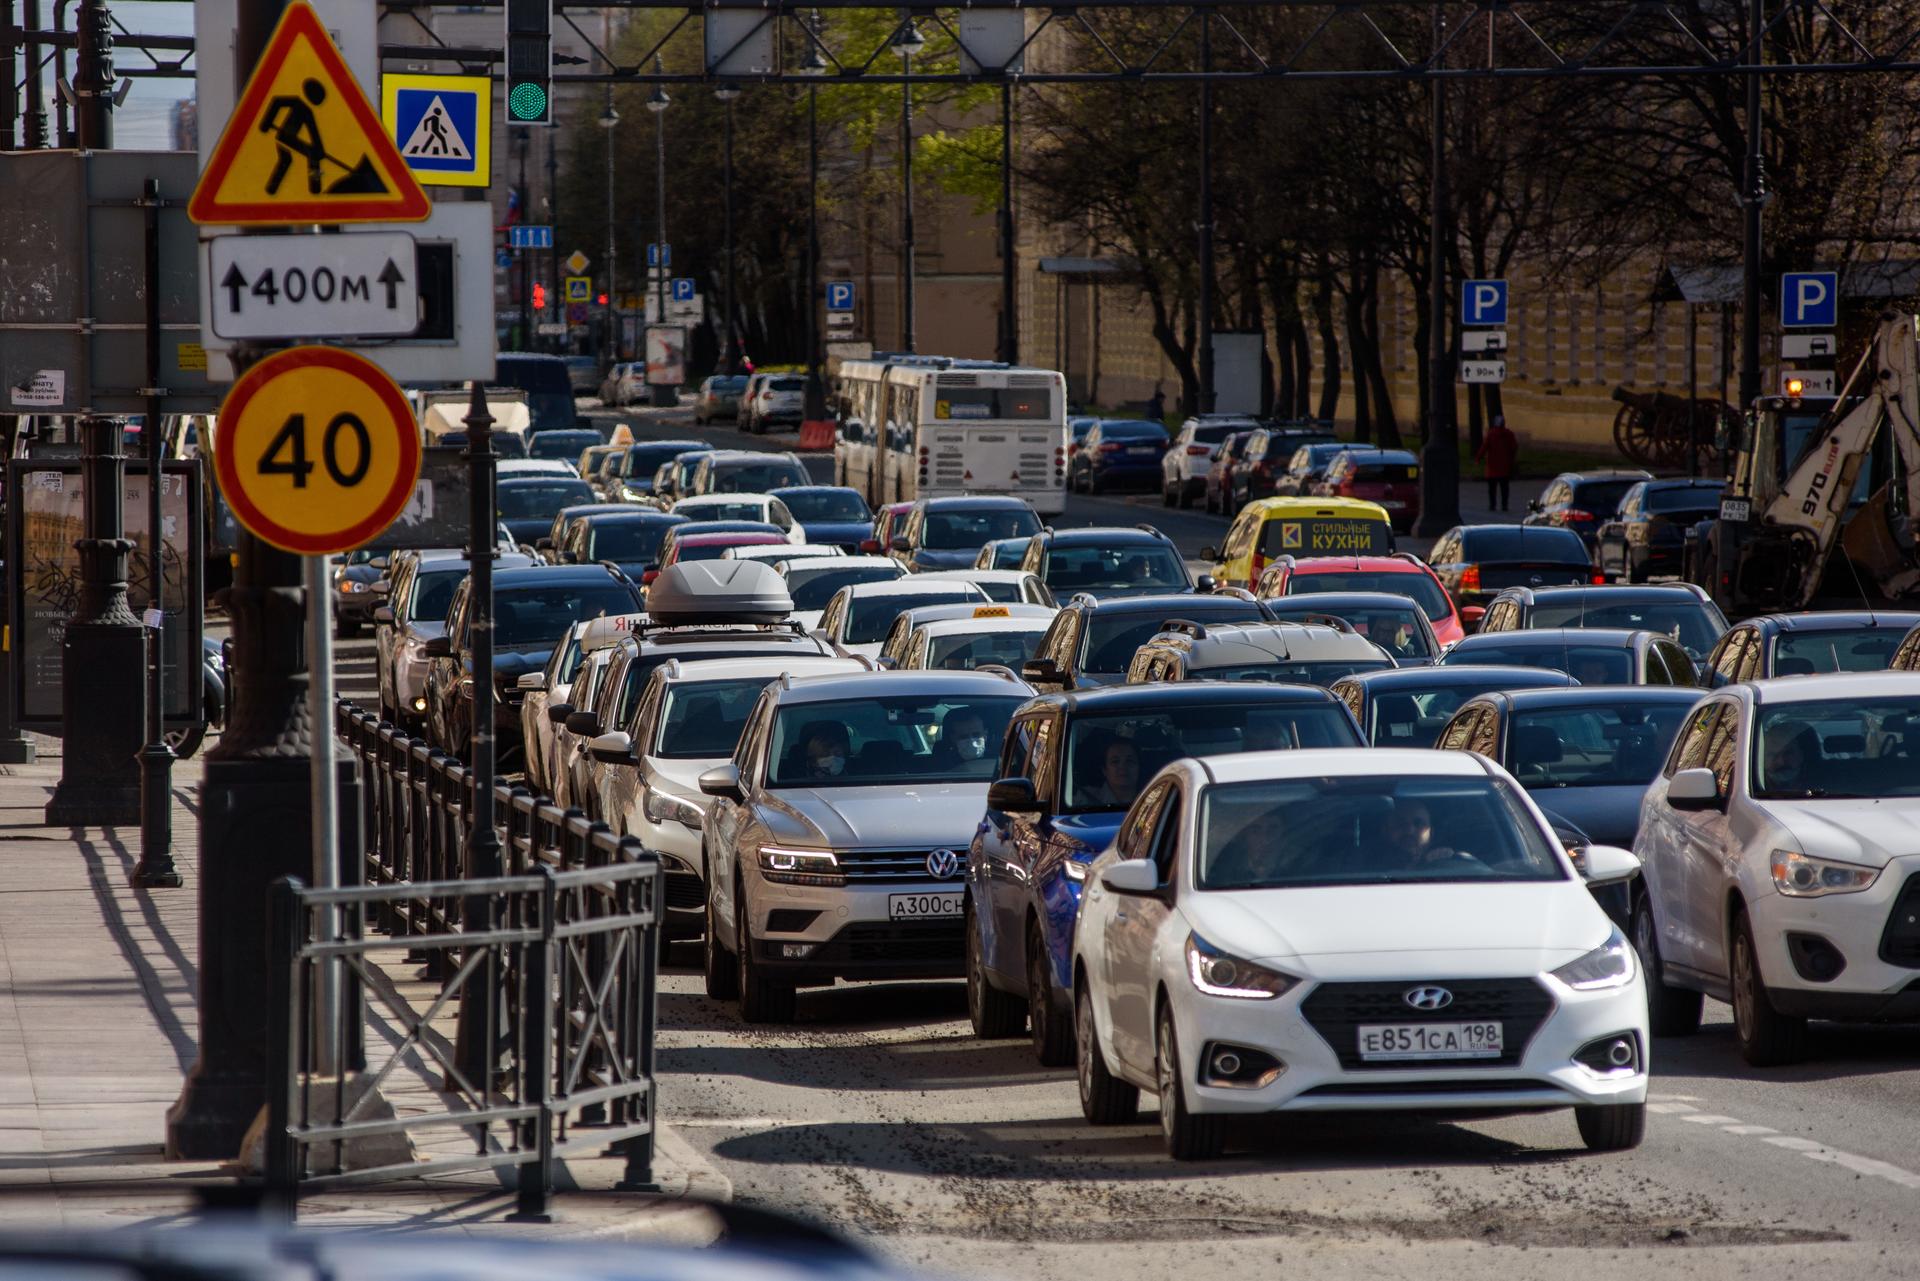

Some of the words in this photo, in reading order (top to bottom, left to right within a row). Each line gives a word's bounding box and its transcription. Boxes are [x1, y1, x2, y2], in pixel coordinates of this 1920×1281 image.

[833, 285, 849, 306] P
[1475, 284, 1500, 320] P
[1797, 279, 1827, 321] P
[258, 412, 371, 488] 40
[1801, 472, 1828, 516] 970
[1312, 523, 1372, 534] СТИЛЬНЫЕ
[1312, 535, 1372, 549] КУХНИ
[1367, 1027, 1458, 1052] Е851СА
[1463, 1025, 1497, 1043] 198
[1470, 1042, 1488, 1050] RUS
